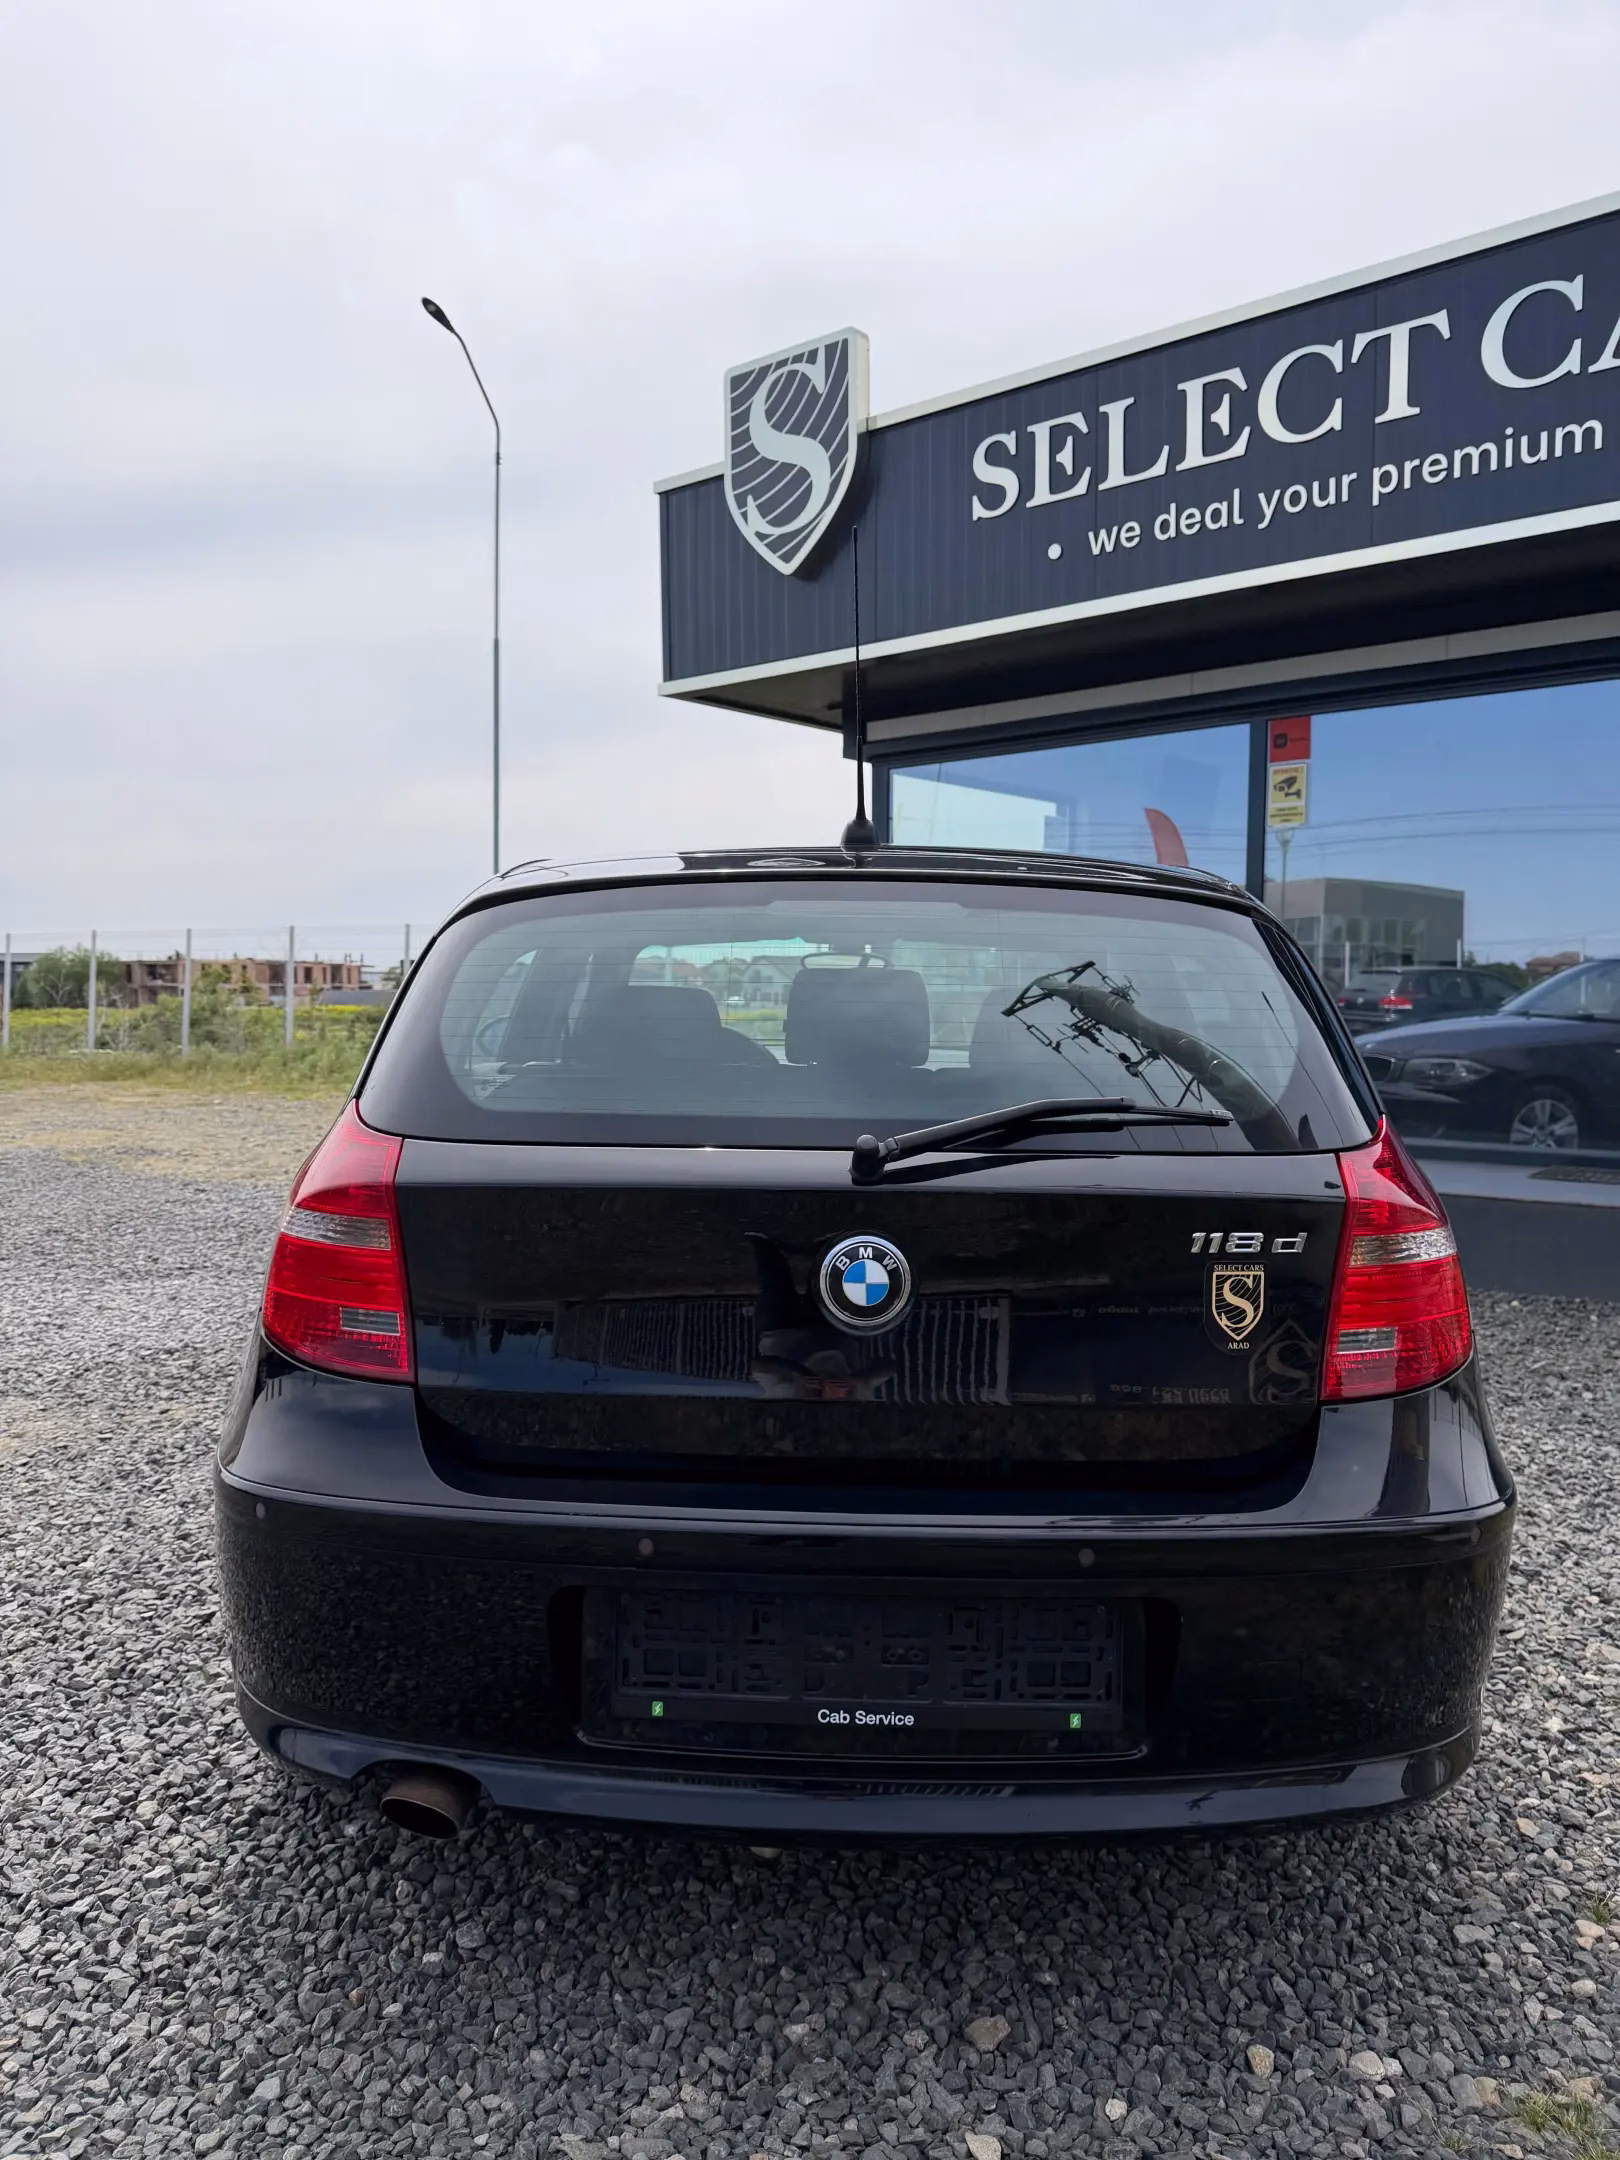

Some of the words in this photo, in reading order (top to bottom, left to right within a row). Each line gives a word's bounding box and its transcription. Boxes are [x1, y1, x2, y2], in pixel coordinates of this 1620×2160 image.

[971, 308, 1452, 522] SELECT
[1087, 519, 1142, 556] we
[1153, 487, 1245, 541] deal
[1257, 471, 1359, 530] your
[1371, 418, 1604, 507] premium
[835, 1246, 899, 1272] BMW
[1213, 1264, 1242, 1272] SELECT
[1243, 1264, 1265, 1272] CARS
[1227, 1342, 1250, 1350] ARAD
[817, 1708, 851, 1724] Cab
[854, 1710, 915, 1726] Service
